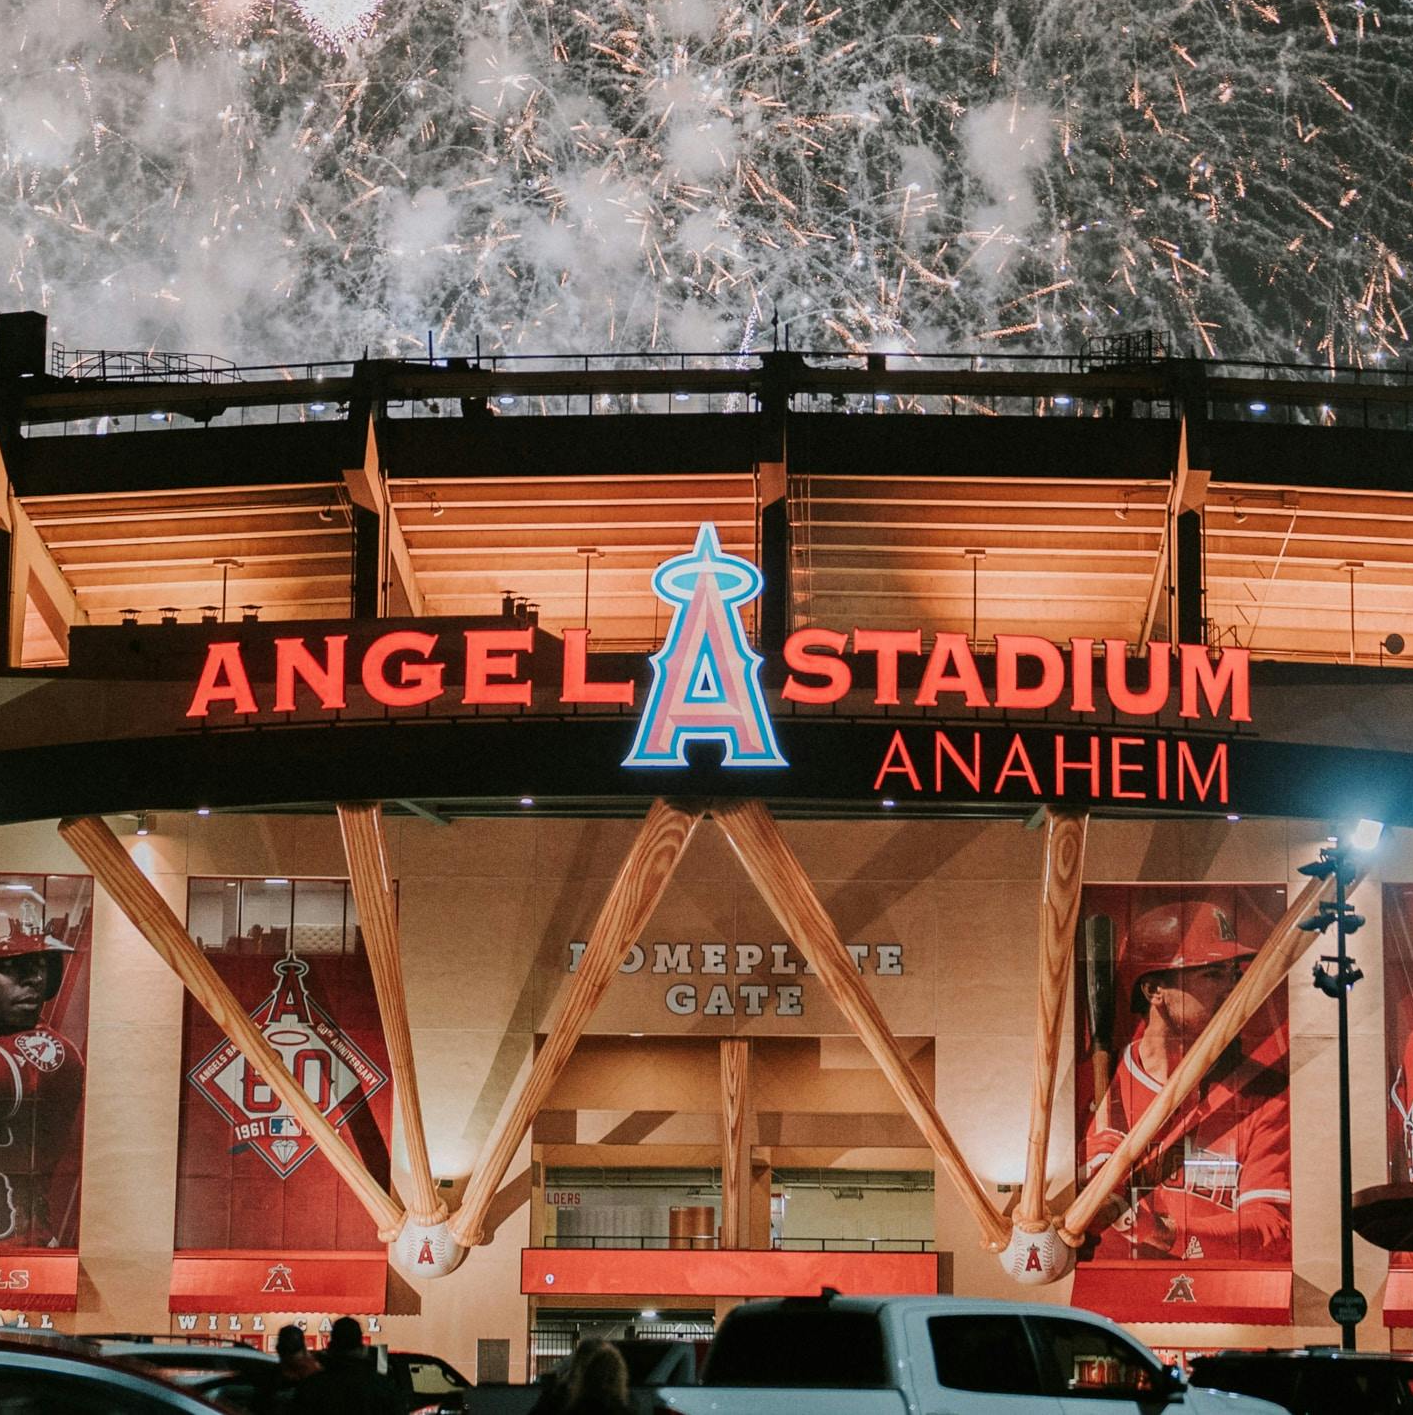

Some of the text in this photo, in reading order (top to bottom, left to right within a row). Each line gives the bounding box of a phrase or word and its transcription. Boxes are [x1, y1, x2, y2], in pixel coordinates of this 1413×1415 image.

[186, 626, 636, 718] ANGEL
[781, 628, 1253, 723] STADIUM
[873, 730, 1229, 805] ANAHEIM
[665, 983, 804, 1016] GATE
[198, 1053, 229, 1083] ANGELS
[330, 1037, 380, 1087] ANNIVERSARY
[234, 1122, 266, 1141] 1961
[177, 1315, 381, 1333] WILL CAL
